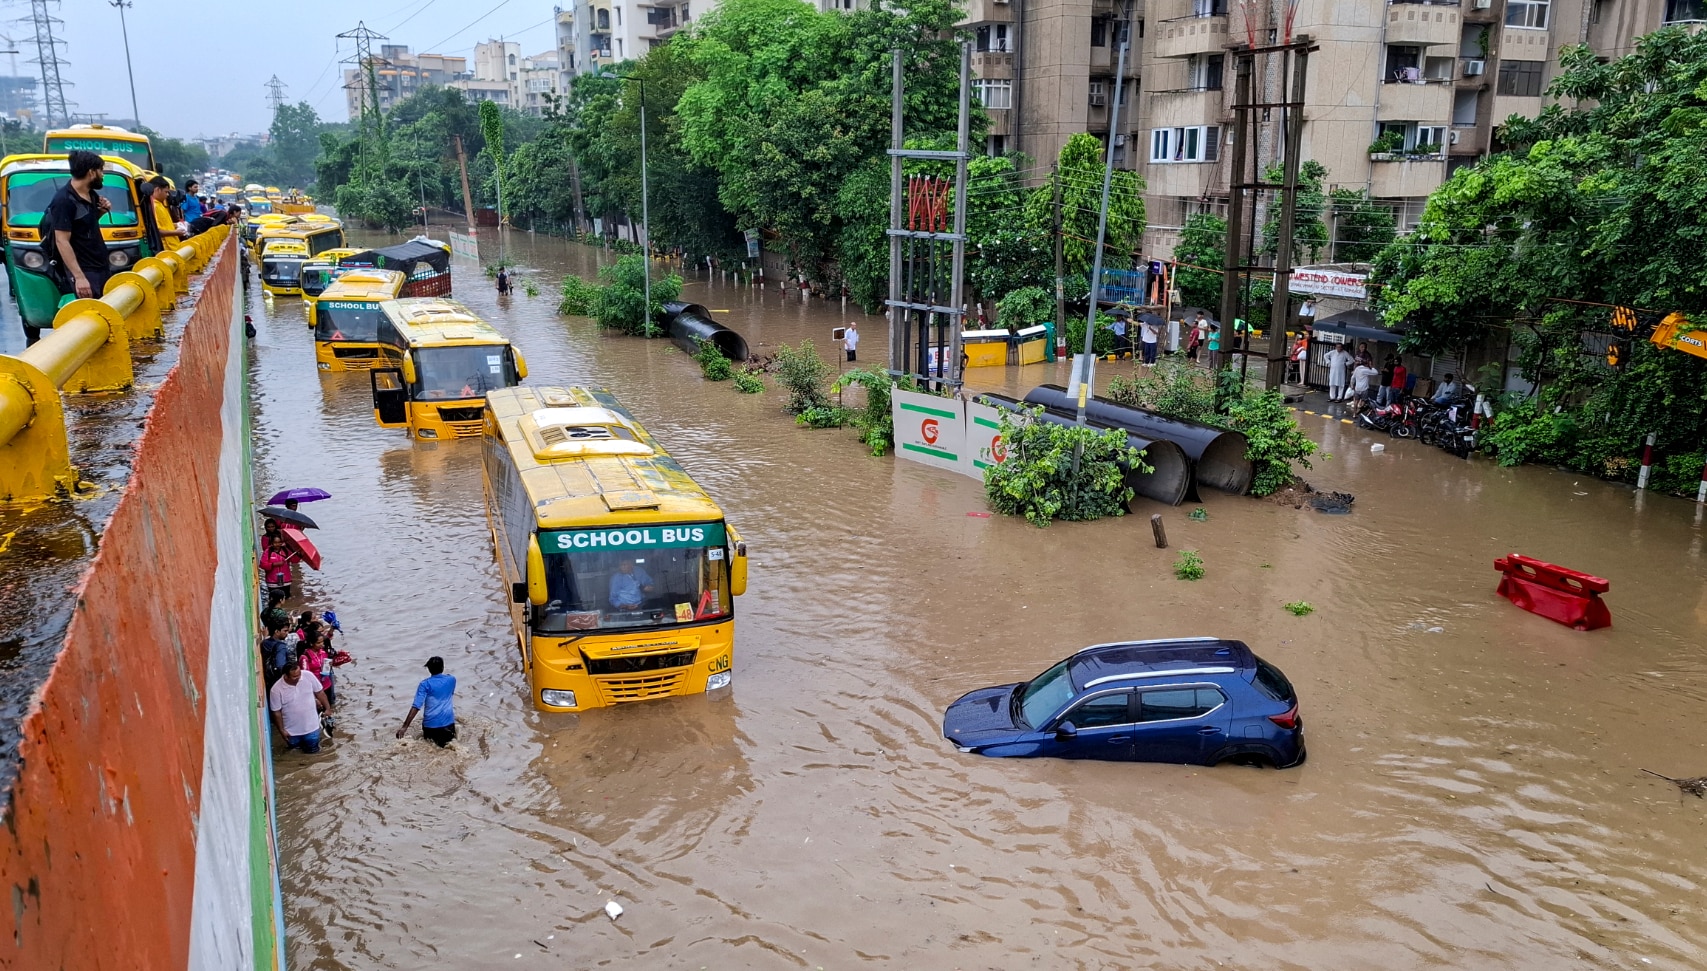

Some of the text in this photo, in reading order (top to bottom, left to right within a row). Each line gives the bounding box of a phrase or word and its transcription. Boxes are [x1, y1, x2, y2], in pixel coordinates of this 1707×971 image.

[64, 140, 133, 152] SCHOOL BUS
[1680, 335, 1702, 347] CORTS
[557, 528, 704, 549] SCHOOL BUS
[676, 608, 692, 620] -48
[708, 654, 729, 672] CNG
